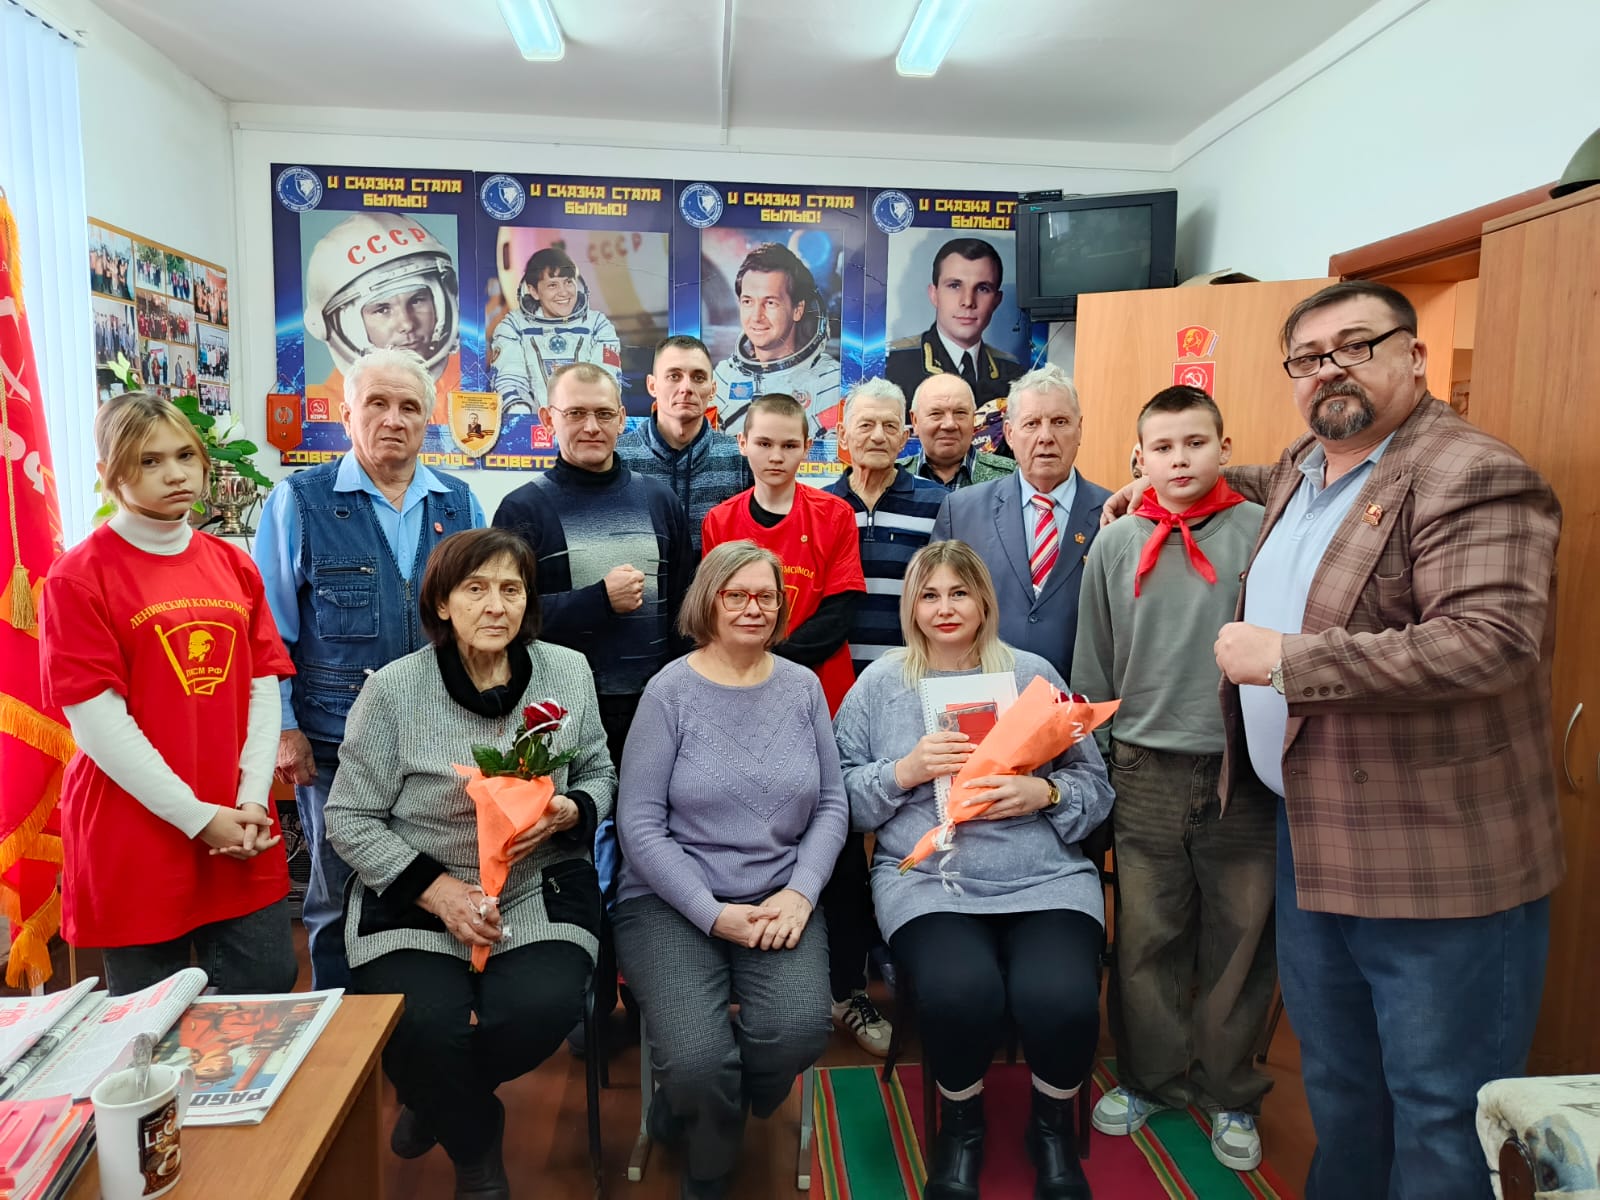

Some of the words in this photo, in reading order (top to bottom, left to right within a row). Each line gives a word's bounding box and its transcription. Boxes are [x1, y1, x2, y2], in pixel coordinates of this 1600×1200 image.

[327, 175, 339, 189] И
[345, 176, 405, 191] СКАЗКА
[411, 178, 463, 193] СТАЛА
[530, 184, 542, 197] И
[547, 184, 607, 199] СКАЗКА
[612, 186, 662, 201] СТАЛА
[363, 193, 428, 208] БЫЛЬЮ!
[727, 192, 739, 205] И
[744, 192, 802, 207] СКАЗКА
[806, 194, 855, 209] СТАЛА
[919, 198, 930, 211] И
[935, 199, 990, 213] СКАЗКА
[565, 201, 628, 216] БЫЛЬЮ!
[761, 208, 822, 223] БЫЛЬЮ!
[951, 215, 1010, 229] БЫЛЬЮ!
[347, 227, 426, 265] СССР
[287, 451, 345, 463] СОВЕТ
[485, 455, 557, 469] СОВЕТС
[130, 597, 192, 629] ЛЕНИНСКИЙ
[194, 598, 250, 623] КОМСОМО
[207, 666, 223, 674] РФ
